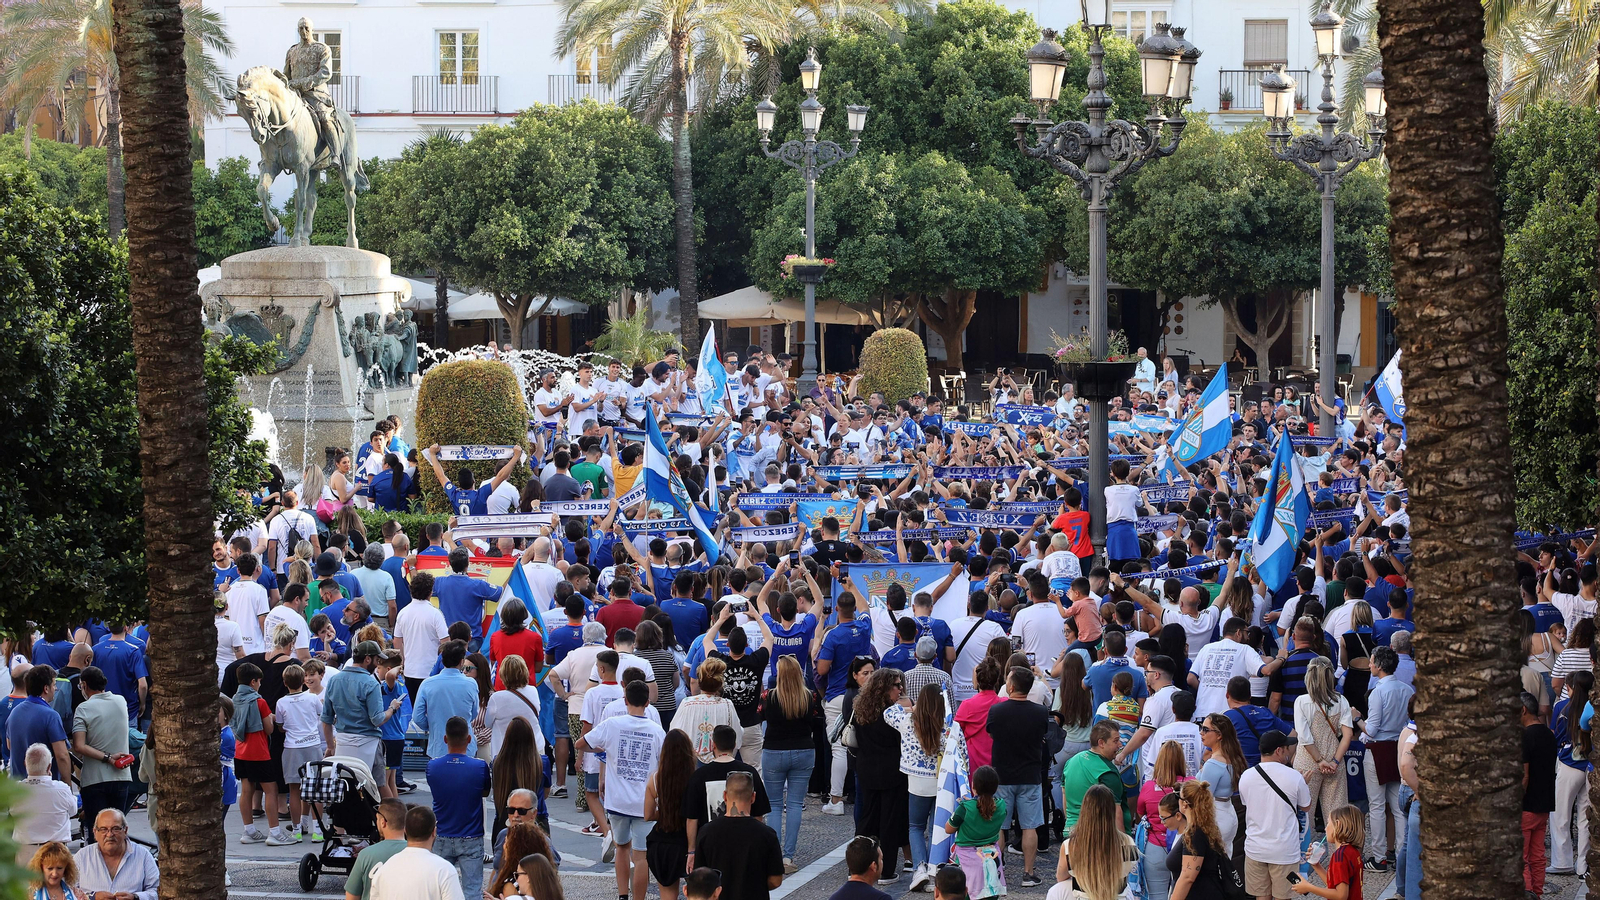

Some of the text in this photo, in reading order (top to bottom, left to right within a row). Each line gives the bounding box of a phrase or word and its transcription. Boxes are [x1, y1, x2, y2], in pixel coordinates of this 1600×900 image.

[738, 497, 767, 505] XEREZ
[768, 497, 791, 505] CLUB
[1071, 525, 1082, 545] 7
[773, 636, 803, 647] NTELONGO
[1346, 757, 1360, 777] 6
